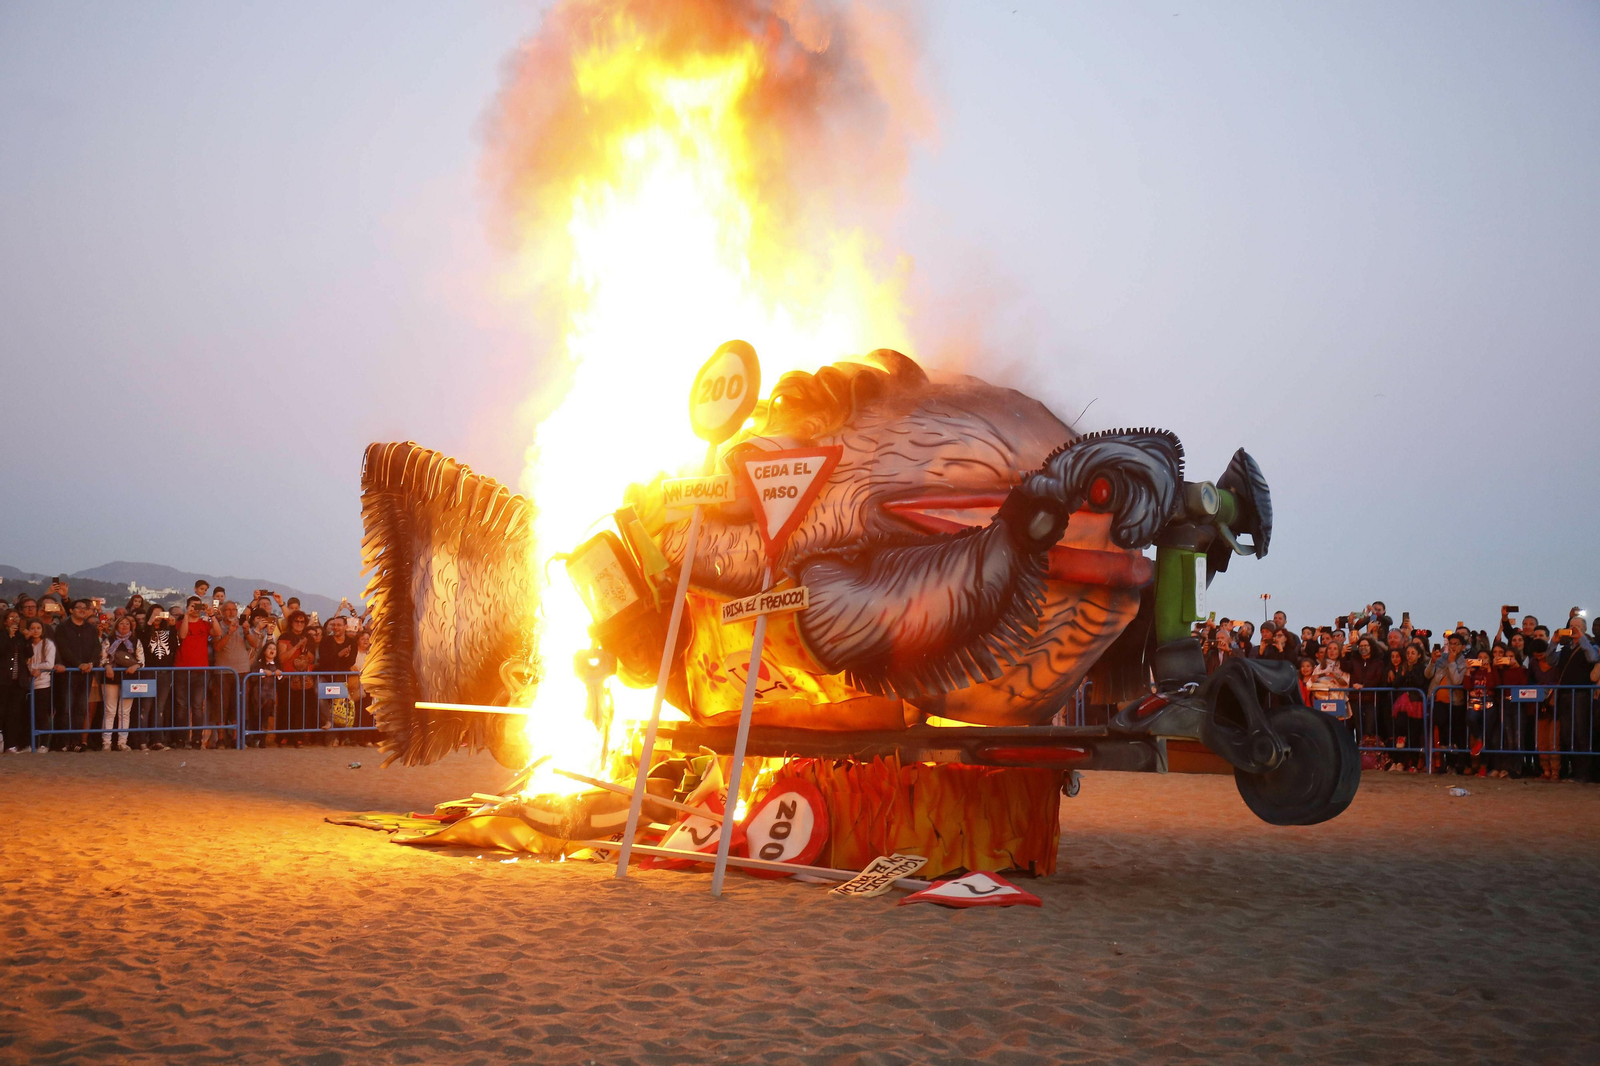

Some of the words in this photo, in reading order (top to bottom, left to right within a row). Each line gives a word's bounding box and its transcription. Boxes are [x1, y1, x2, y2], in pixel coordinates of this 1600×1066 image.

[698, 374, 744, 405] 200
[754, 464, 789, 480] CEDA
[793, 462, 812, 476] EL
[763, 485, 798, 501] PASO
[745, 598, 757, 612] EL
[759, 800, 797, 860] 200
